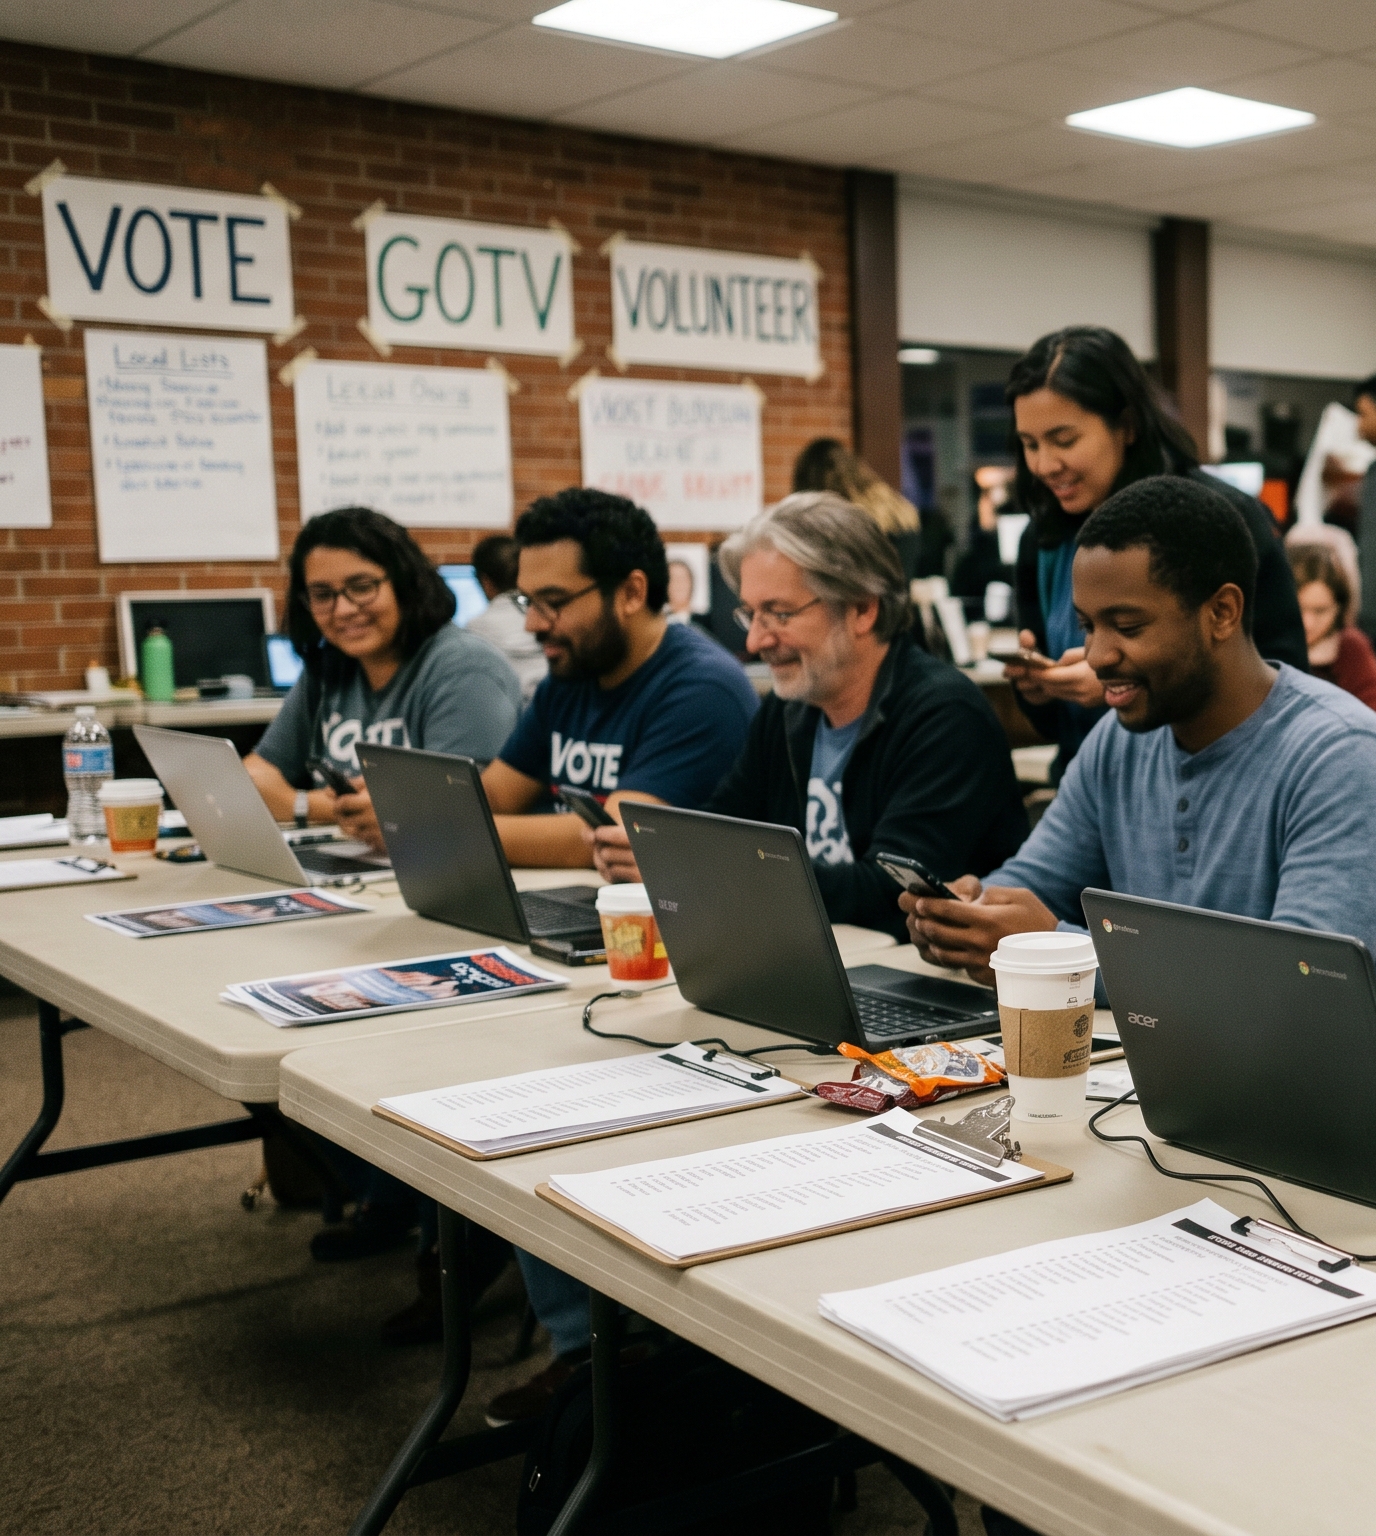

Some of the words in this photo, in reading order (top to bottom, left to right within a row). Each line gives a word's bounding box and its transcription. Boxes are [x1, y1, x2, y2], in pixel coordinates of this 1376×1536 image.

[56, 201, 272, 305] VOTE
[376, 234, 562, 331] GOTV
[616, 265, 812, 344] VOLUNTEER
[551, 731, 624, 790] VOTE
[1127, 1011, 1159, 1028] acer
